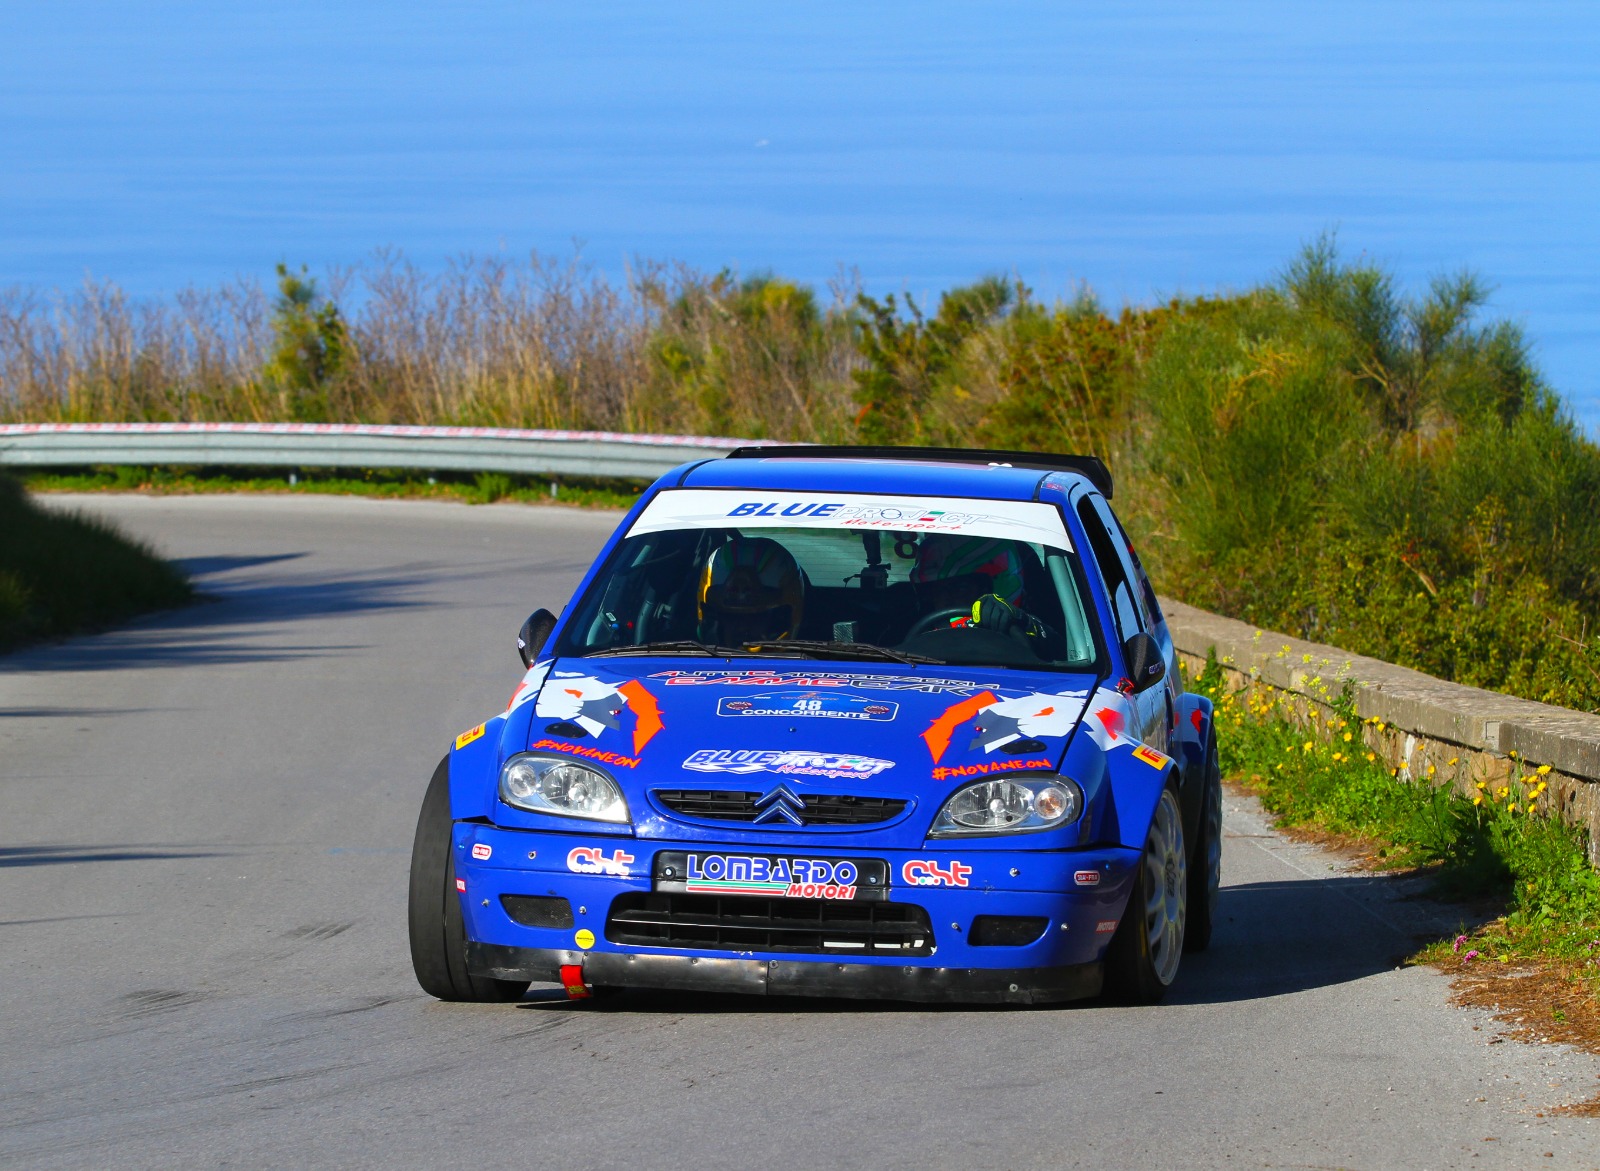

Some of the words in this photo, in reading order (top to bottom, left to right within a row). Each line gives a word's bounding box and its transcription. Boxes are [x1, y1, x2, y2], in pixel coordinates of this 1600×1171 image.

[840, 518, 962, 531] Motorsport
[792, 699, 821, 711] 48
[742, 709, 870, 719] CONCORRENTE
[532, 739, 642, 769] #NOVANEON
[932, 759, 1052, 780] #NOVANEON
[687, 855, 858, 885] LOMBARDO
[786, 884, 857, 900] MOTORI
